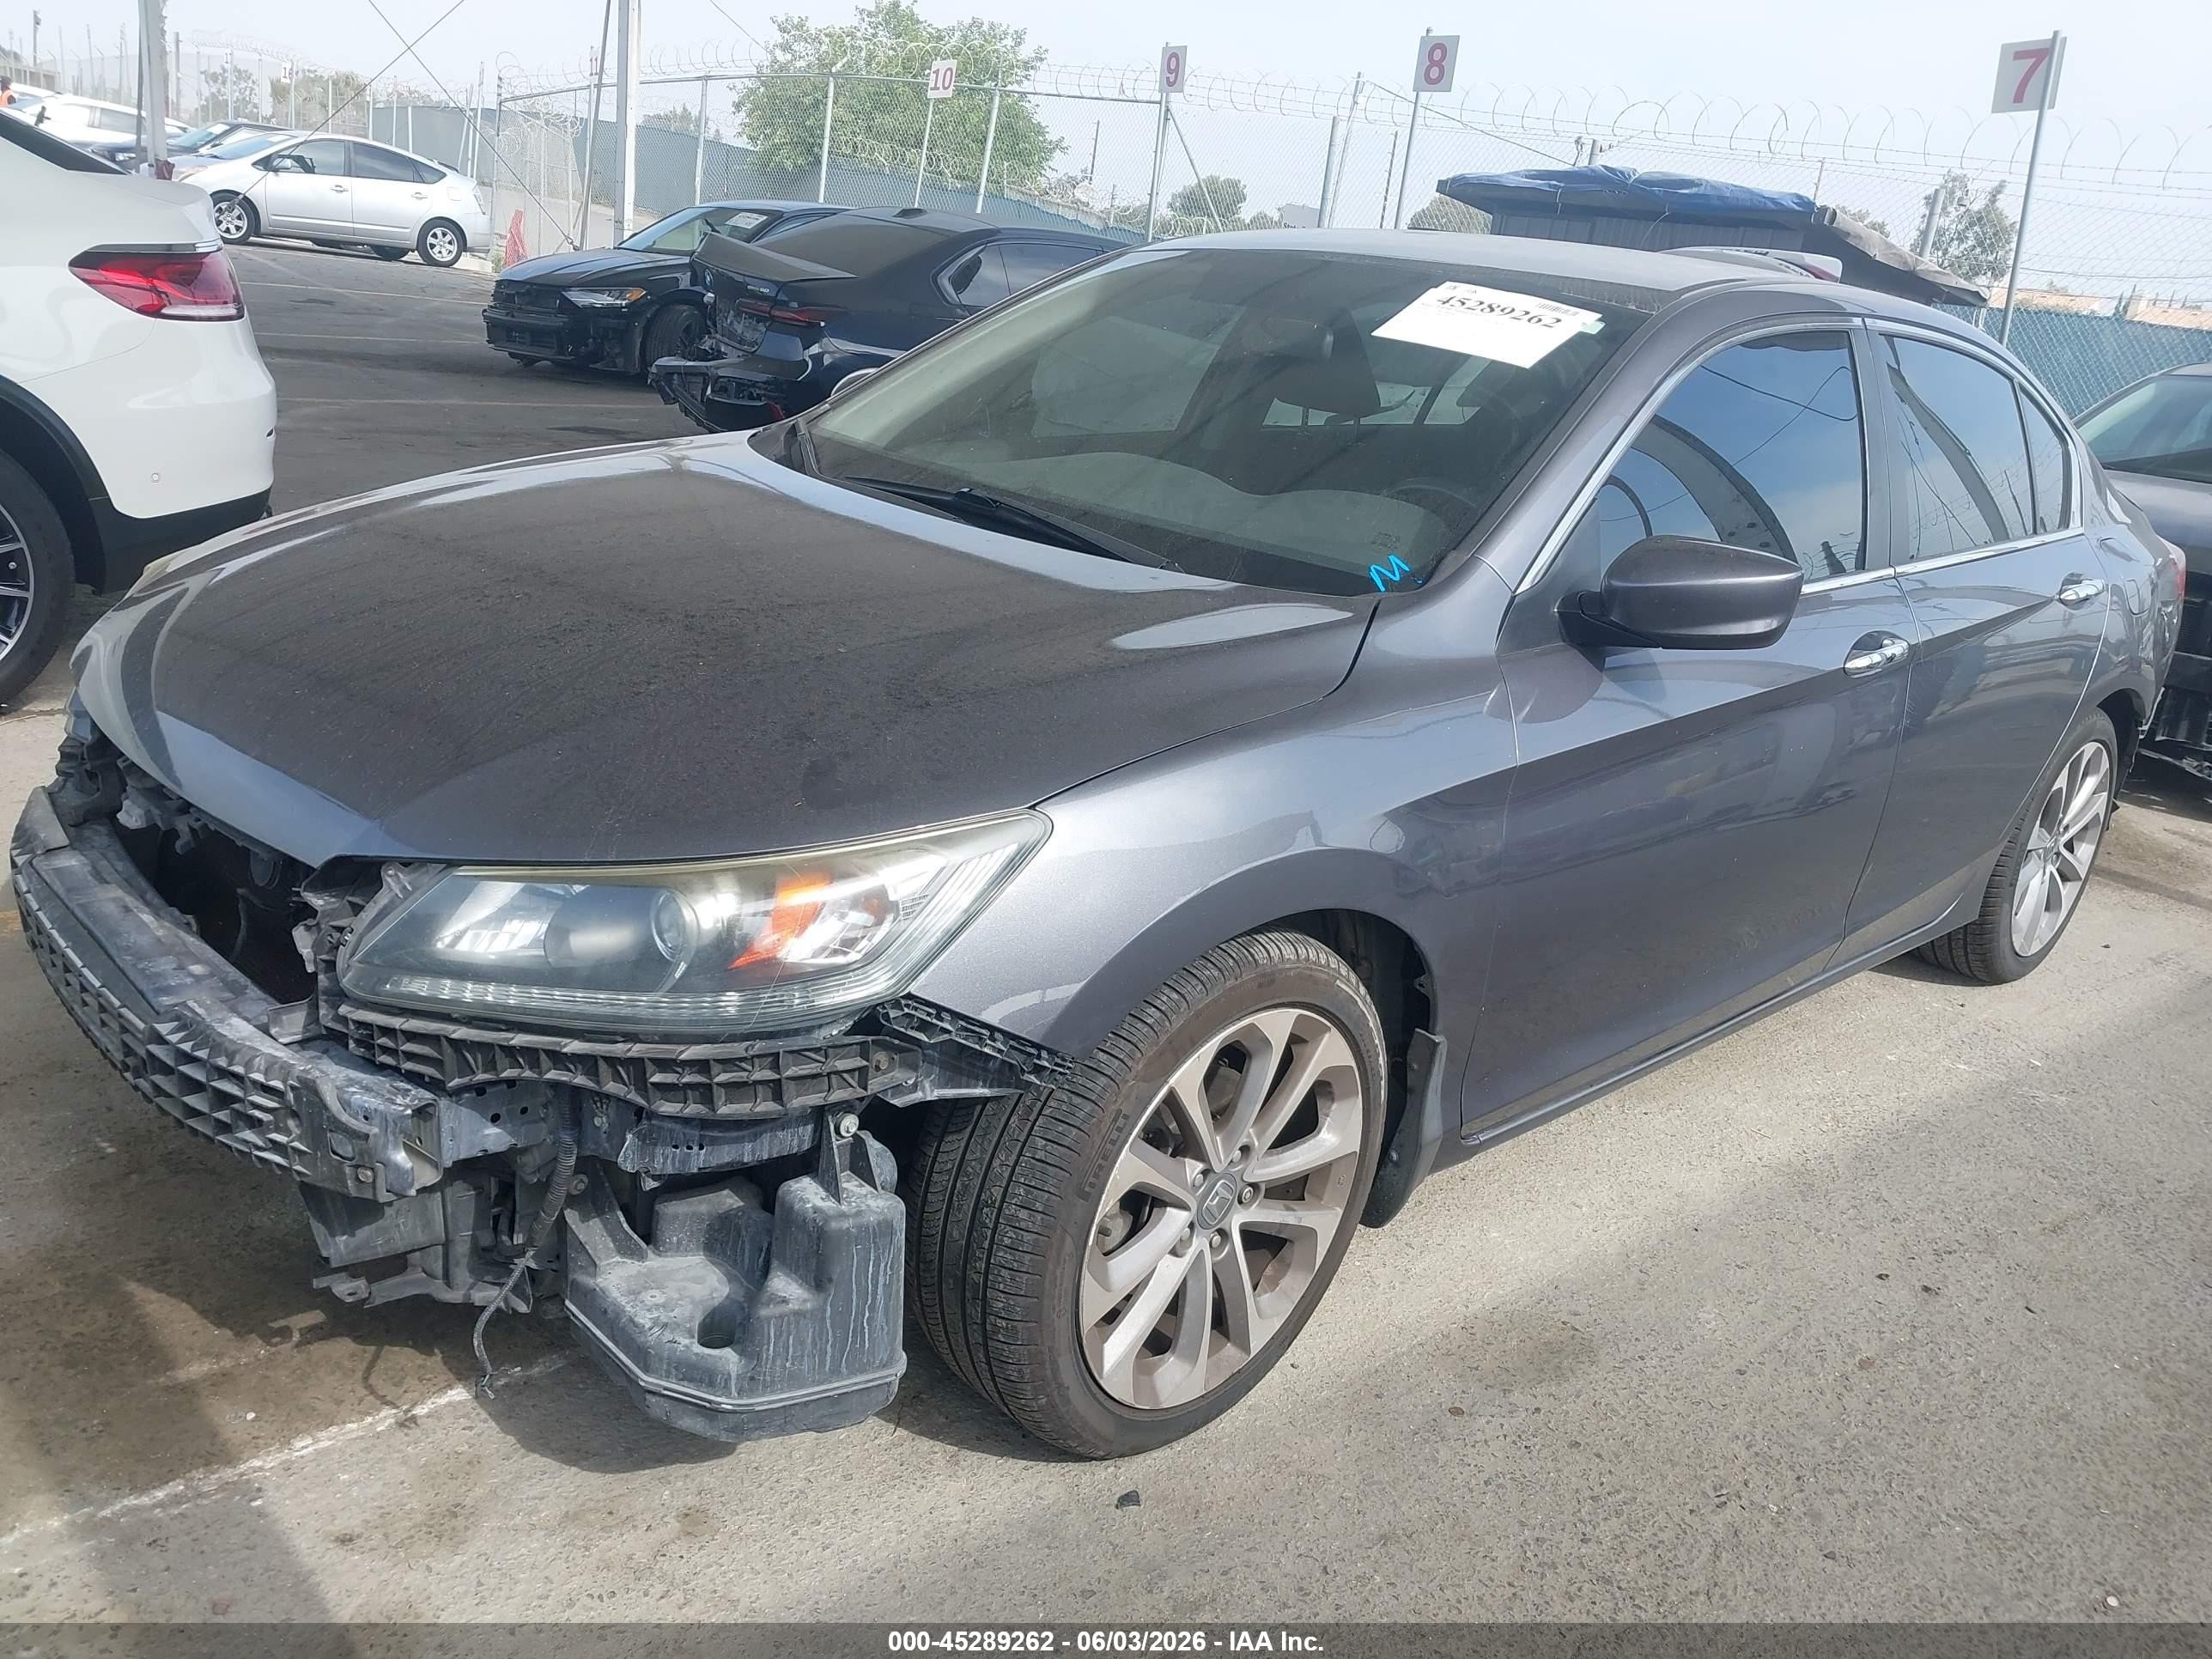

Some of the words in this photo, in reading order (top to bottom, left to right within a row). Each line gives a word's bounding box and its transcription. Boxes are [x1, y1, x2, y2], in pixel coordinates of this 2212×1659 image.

[589, 56, 599, 76] 11
[929, 67, 954, 91] 10
[1165, 52, 1180, 88] 9
[1424, 42, 1448, 86] 8
[2012, 47, 2050, 104] 7
[1436, 295, 1563, 328] 45289262
